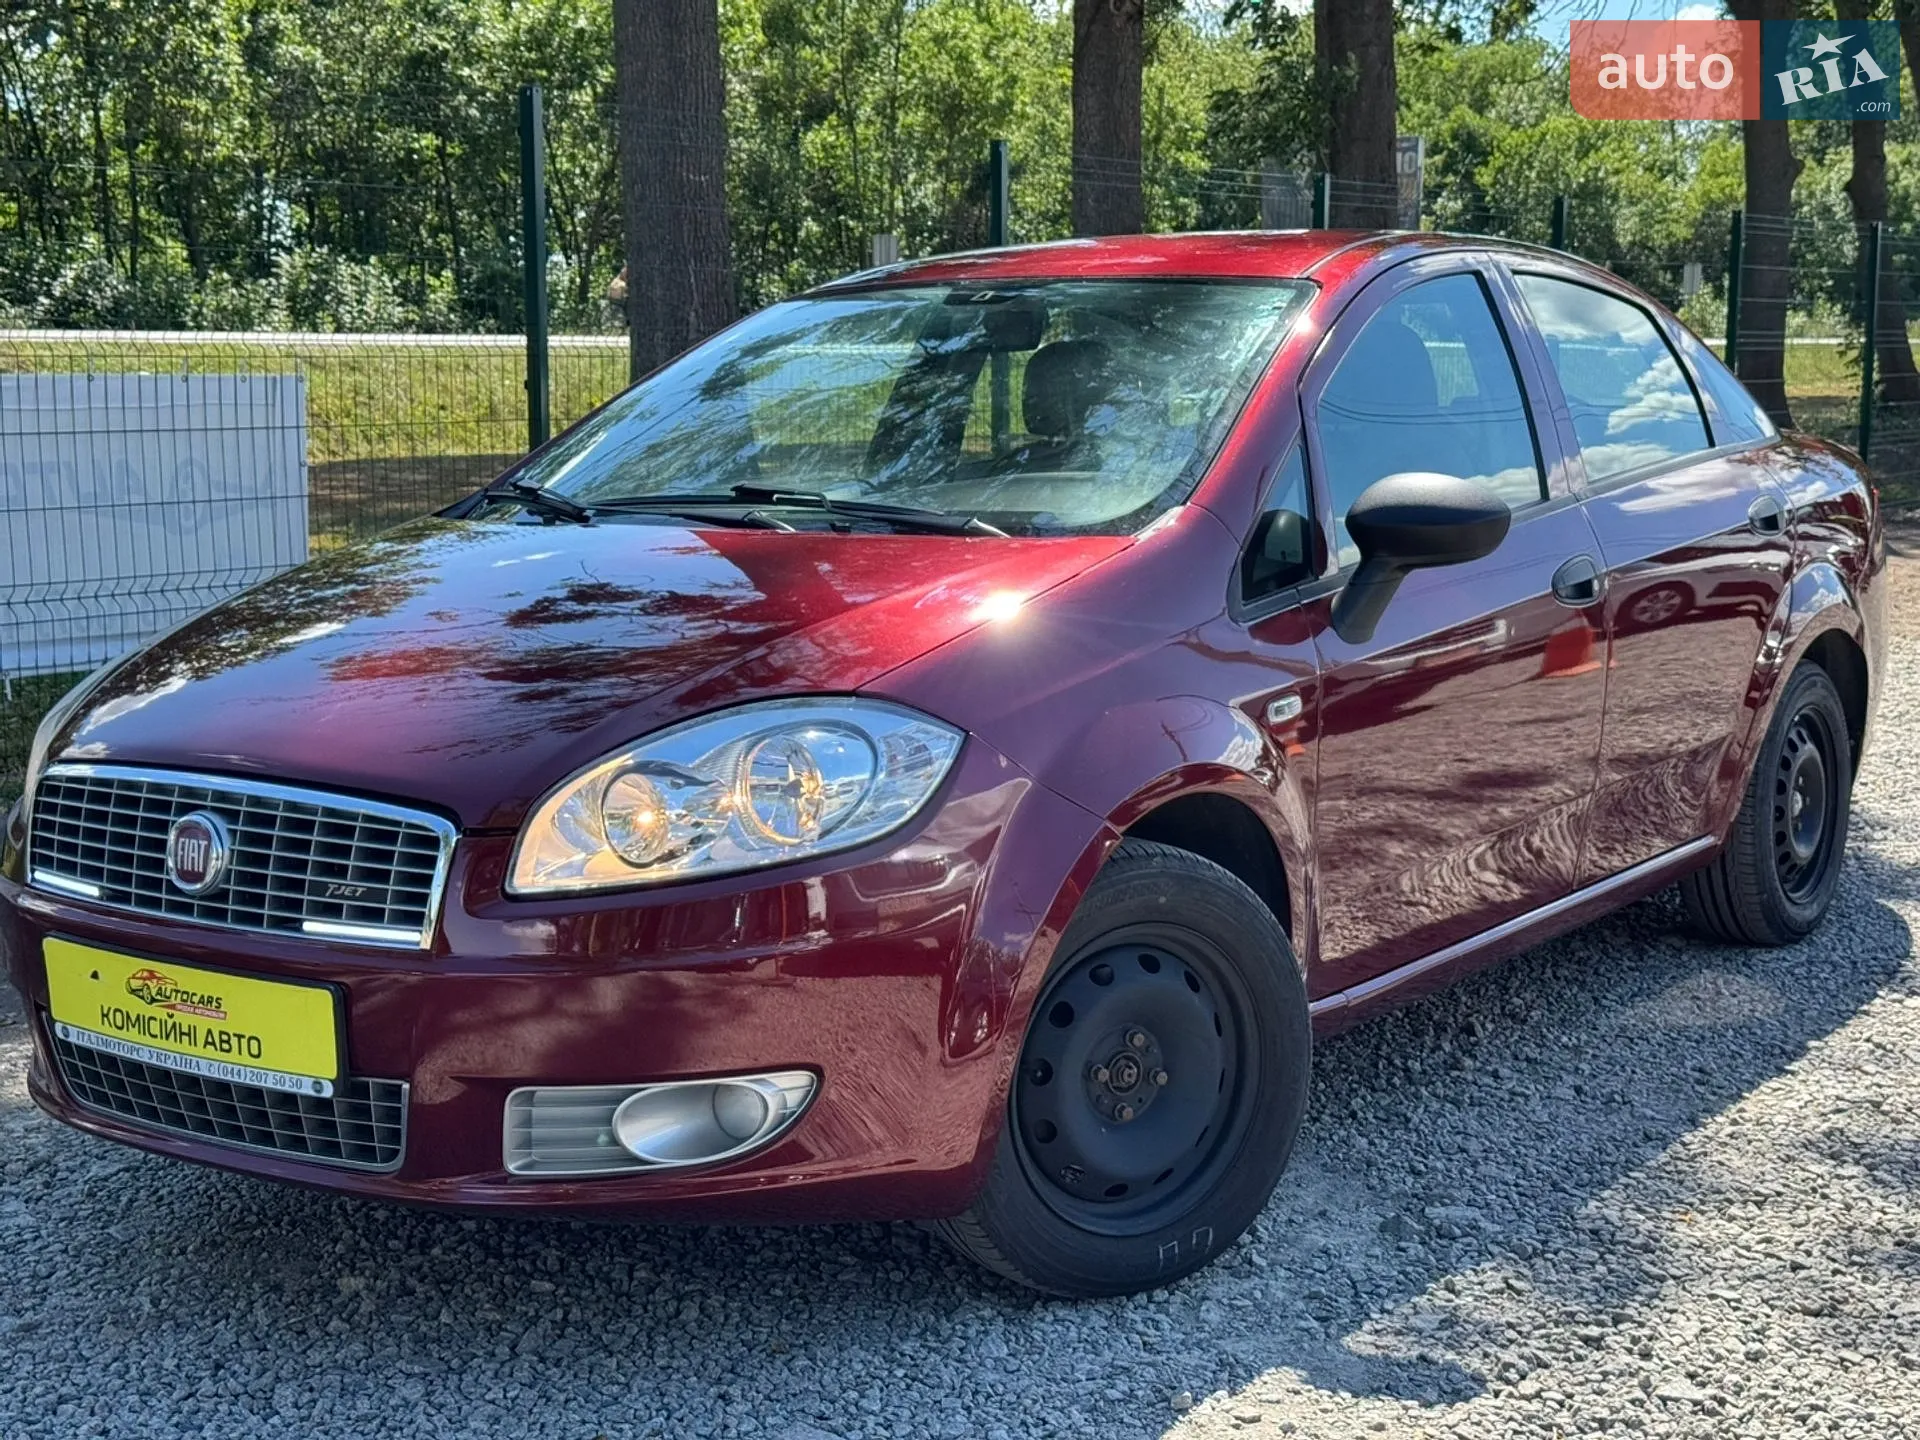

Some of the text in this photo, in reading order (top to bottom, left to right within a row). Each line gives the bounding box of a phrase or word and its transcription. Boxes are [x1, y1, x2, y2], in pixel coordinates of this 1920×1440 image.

[177, 838, 208, 873] FIAT
[325, 883, 367, 897] TJET
[155, 986, 223, 1009] AUTOCARS
[100, 1004, 198, 1048] КОМІСІЙНІ
[203, 1028, 262, 1059] АВТО
[147, 1049, 201, 1072] УКРАЇНА
[272, 1074, 286, 1087] 50
[288, 1077, 303, 1090] 50
